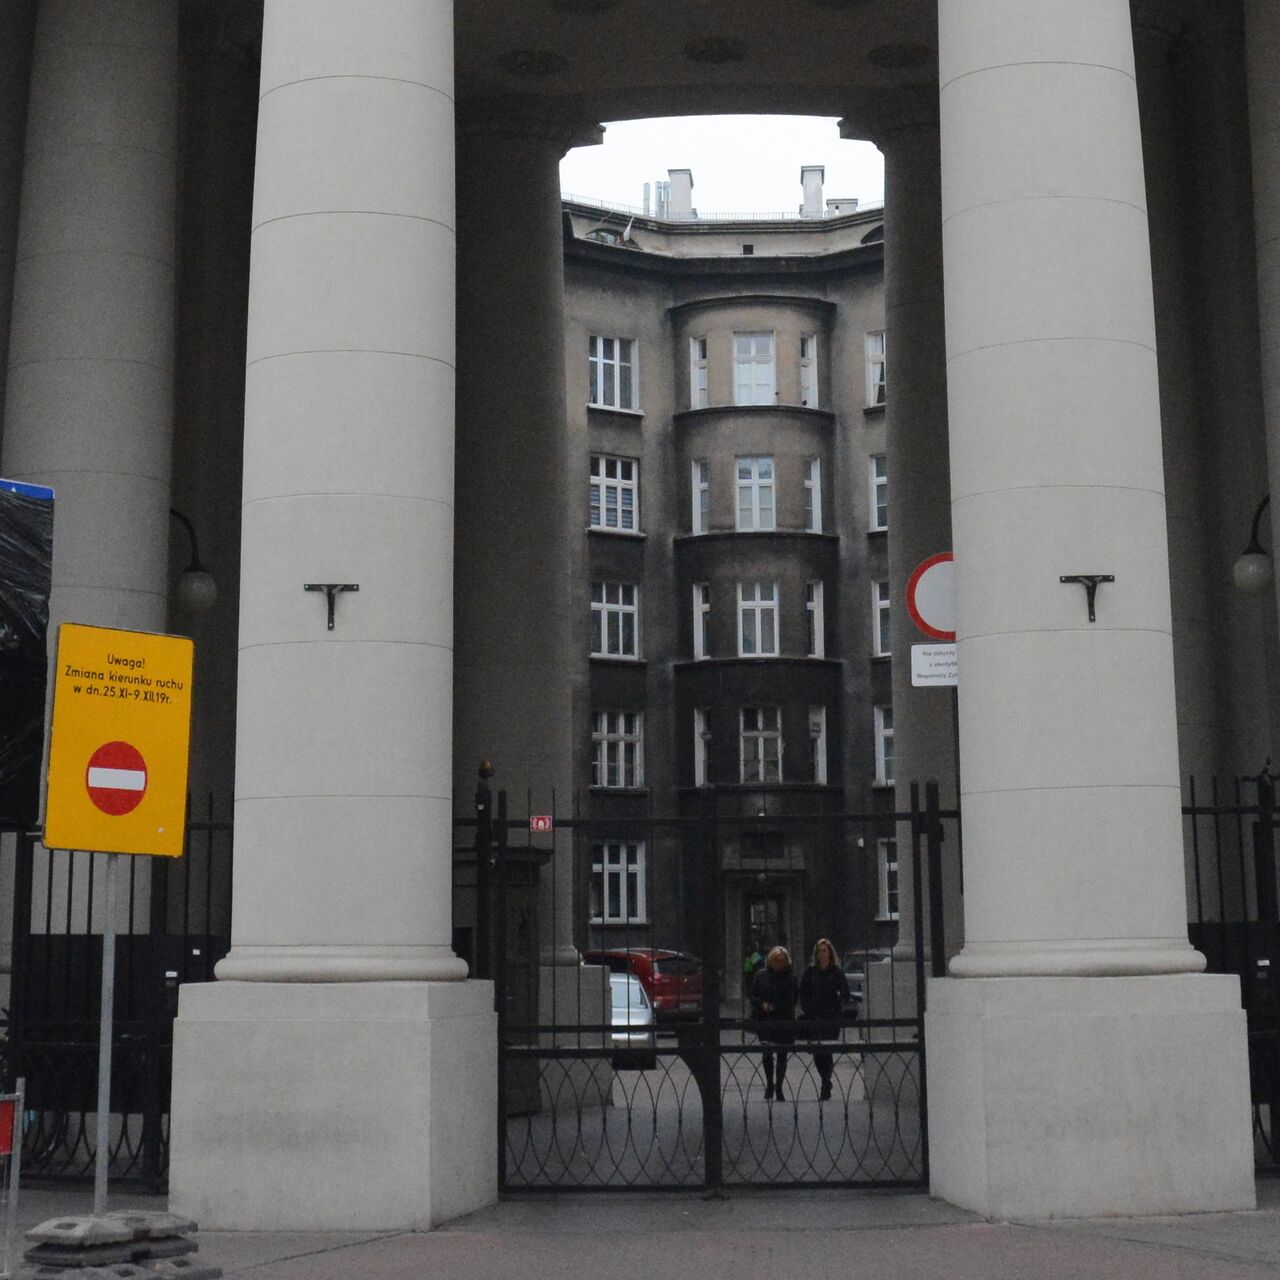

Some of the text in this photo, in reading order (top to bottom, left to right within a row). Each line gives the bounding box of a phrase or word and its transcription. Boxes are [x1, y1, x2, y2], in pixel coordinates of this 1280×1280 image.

[107, 653, 145, 670] Uwaga!
[65, 665, 183, 690] Zmiana kierunku ruchu
[73, 685, 81, 693] w
